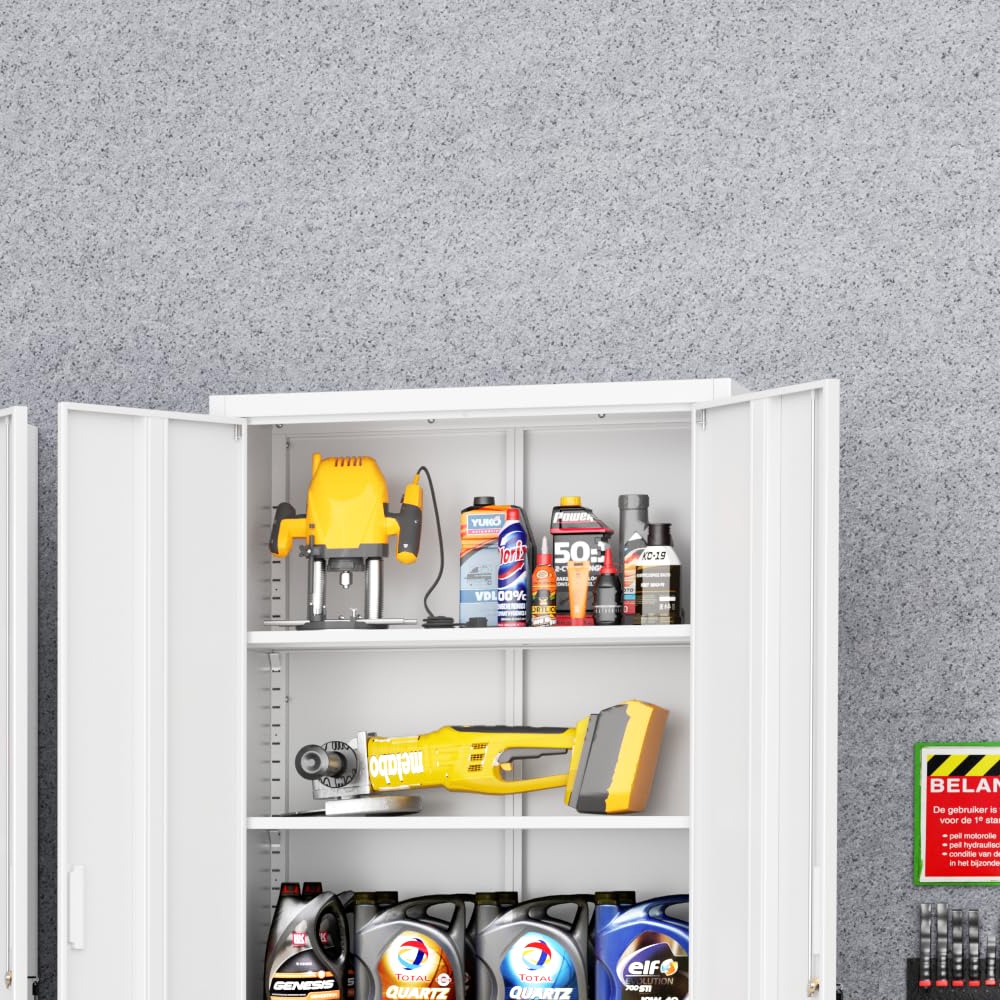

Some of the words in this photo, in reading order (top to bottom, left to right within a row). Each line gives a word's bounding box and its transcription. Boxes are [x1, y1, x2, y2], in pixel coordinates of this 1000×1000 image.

[932, 806, 946, 814] De
[947, 806, 988, 816] gebruiker
[989, 806, 998, 814] is
[940, 817, 959, 825] voor
[960, 816, 972, 825] de
[963, 832, 997, 840] motorolie
[628, 960, 660, 975] elf
[273, 979, 335, 991] GENESIS
[626, 977, 674, 985] EVOLUTION
[385, 985, 451, 1000] QUARTZ
[509, 985, 573, 1000] QUARTZ
